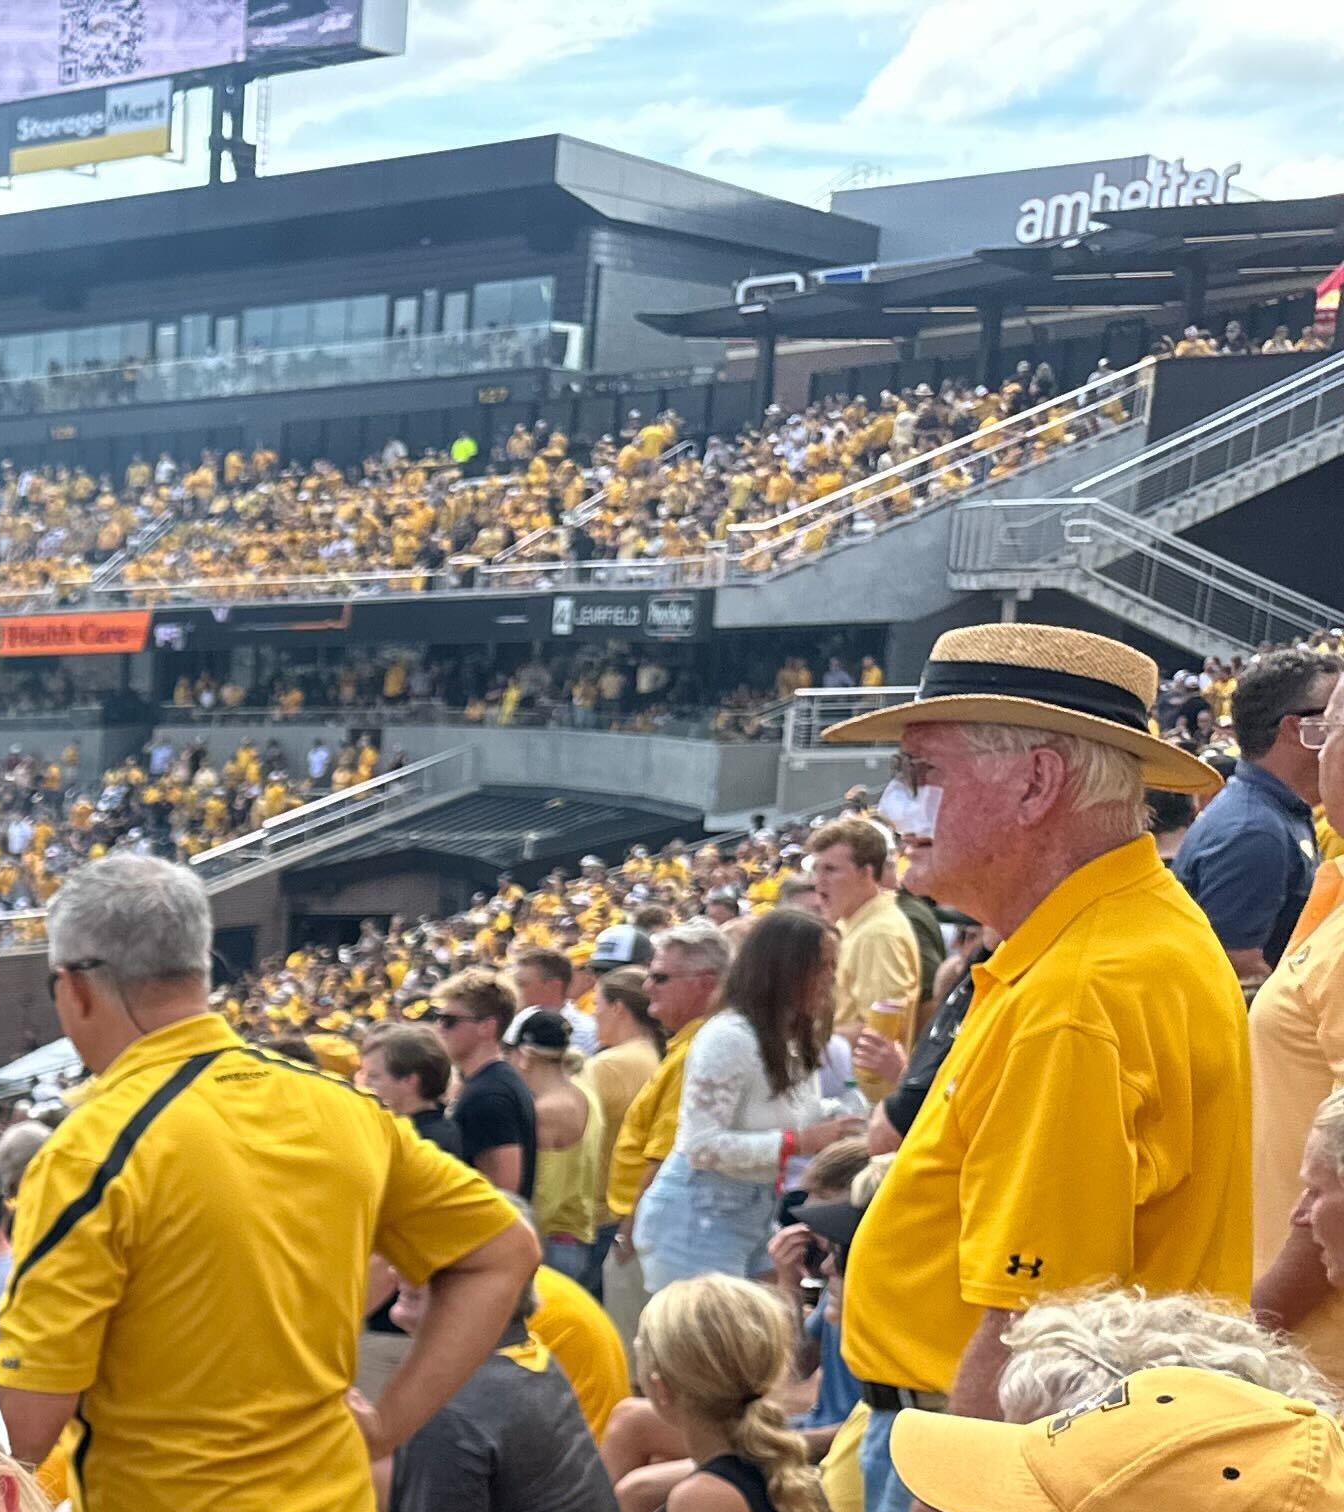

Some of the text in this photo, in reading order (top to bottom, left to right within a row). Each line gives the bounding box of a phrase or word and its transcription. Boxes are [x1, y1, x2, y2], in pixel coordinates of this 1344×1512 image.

[1015, 158, 1242, 245] ambetter
[8, 620, 129, 648] Health Care
